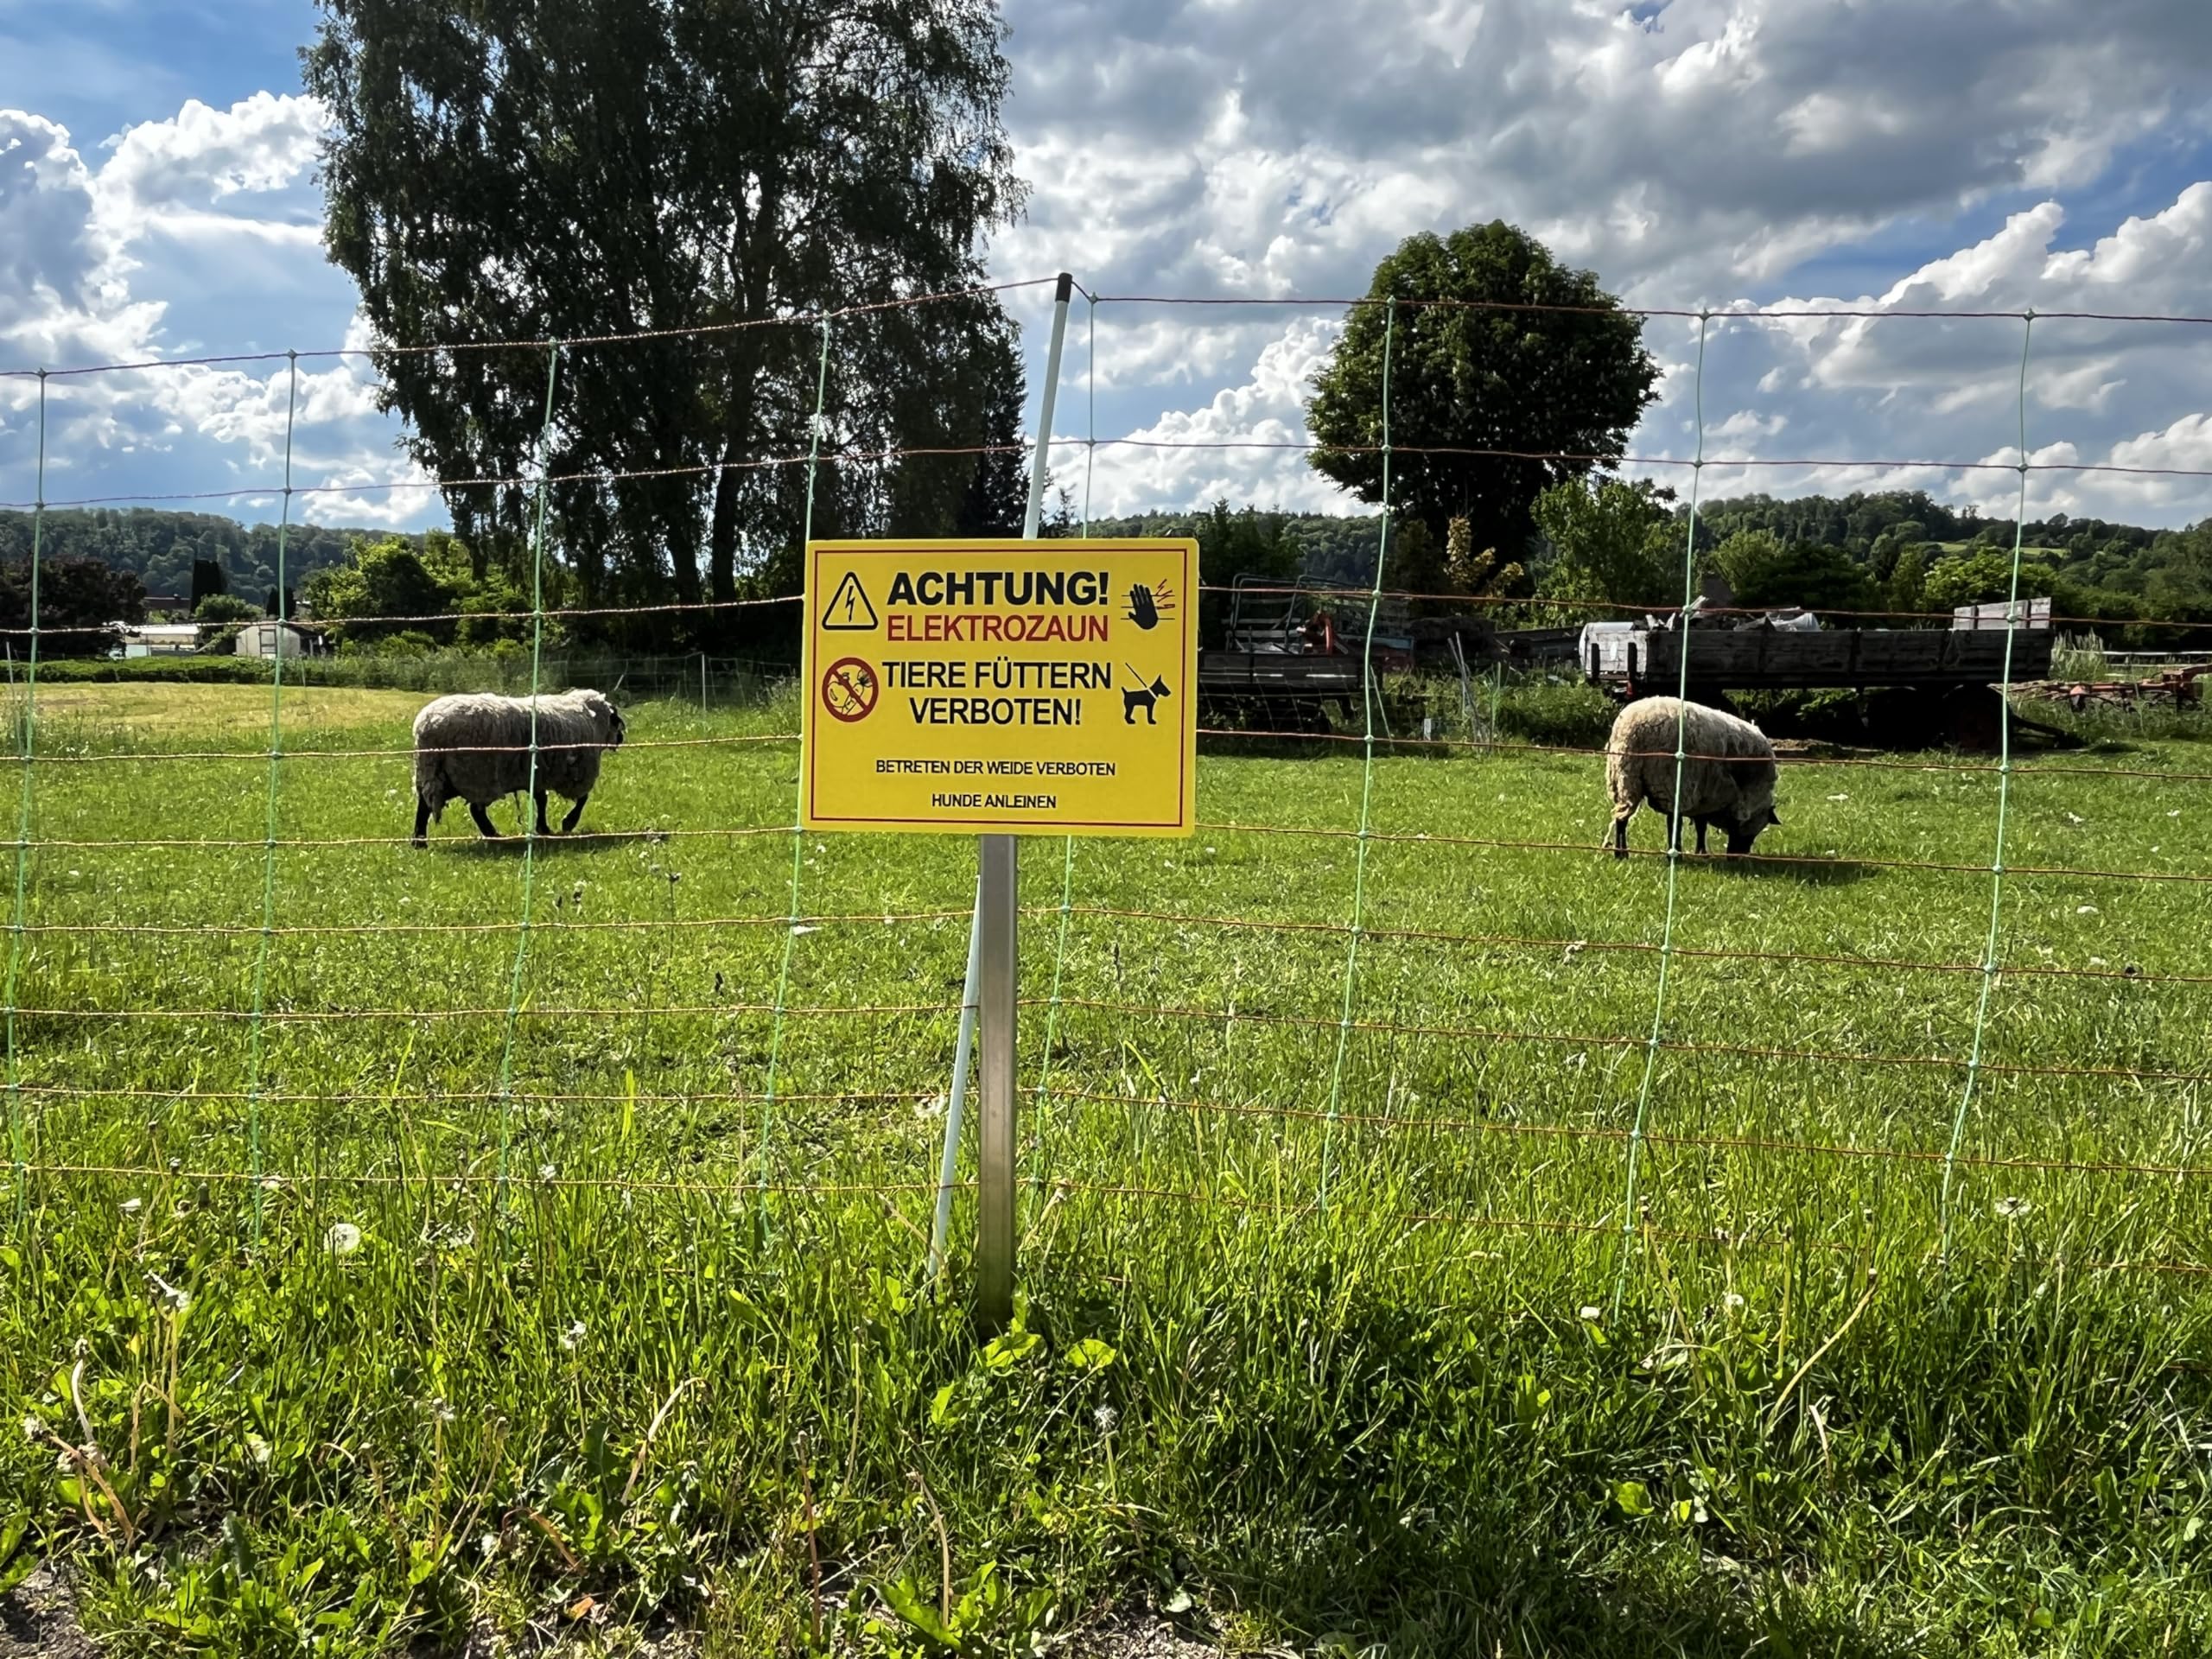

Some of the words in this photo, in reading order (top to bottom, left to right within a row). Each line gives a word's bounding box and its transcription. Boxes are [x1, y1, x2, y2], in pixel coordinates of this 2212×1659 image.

[887, 571, 1109, 606] ACHTUNG!
[887, 614, 1109, 642] ELEKTROZAUN
[882, 661, 966, 688] TIERE
[975, 656, 1111, 689] FÜTTERN
[909, 697, 1081, 725] VERBOTEN!
[876, 760, 950, 775] BETRETEN
[954, 760, 983, 775] DER
[987, 760, 1033, 775] WEIDE
[1037, 761, 1116, 776] VERBOTEN
[932, 793, 982, 808] HUNDE
[984, 794, 1056, 809] ANLEINEN
